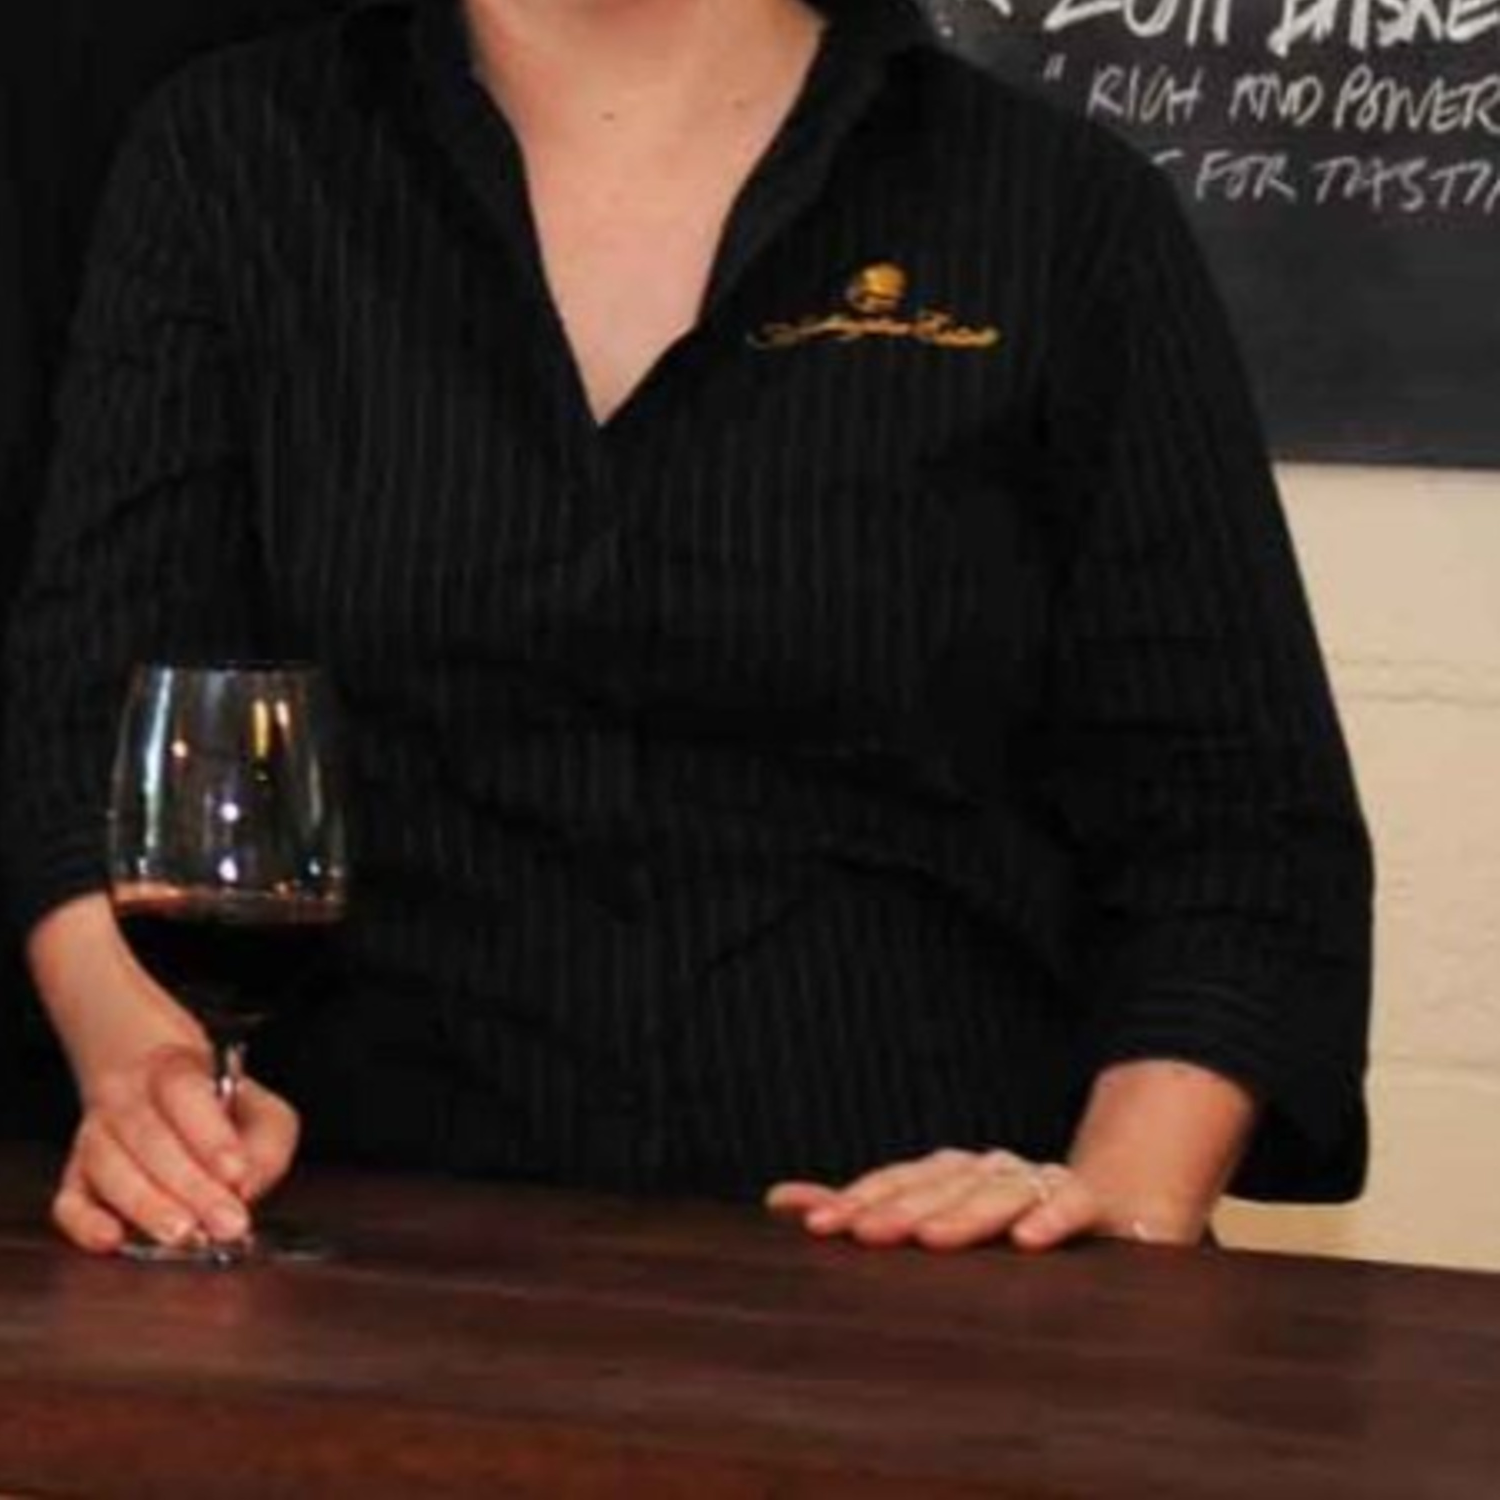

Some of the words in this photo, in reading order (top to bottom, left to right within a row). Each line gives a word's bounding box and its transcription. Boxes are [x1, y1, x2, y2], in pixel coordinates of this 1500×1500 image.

[1228, 73, 1324, 125] AND
[1197, 150, 1296, 198] FOR
[1313, 155, 1500, 213] TASTI
